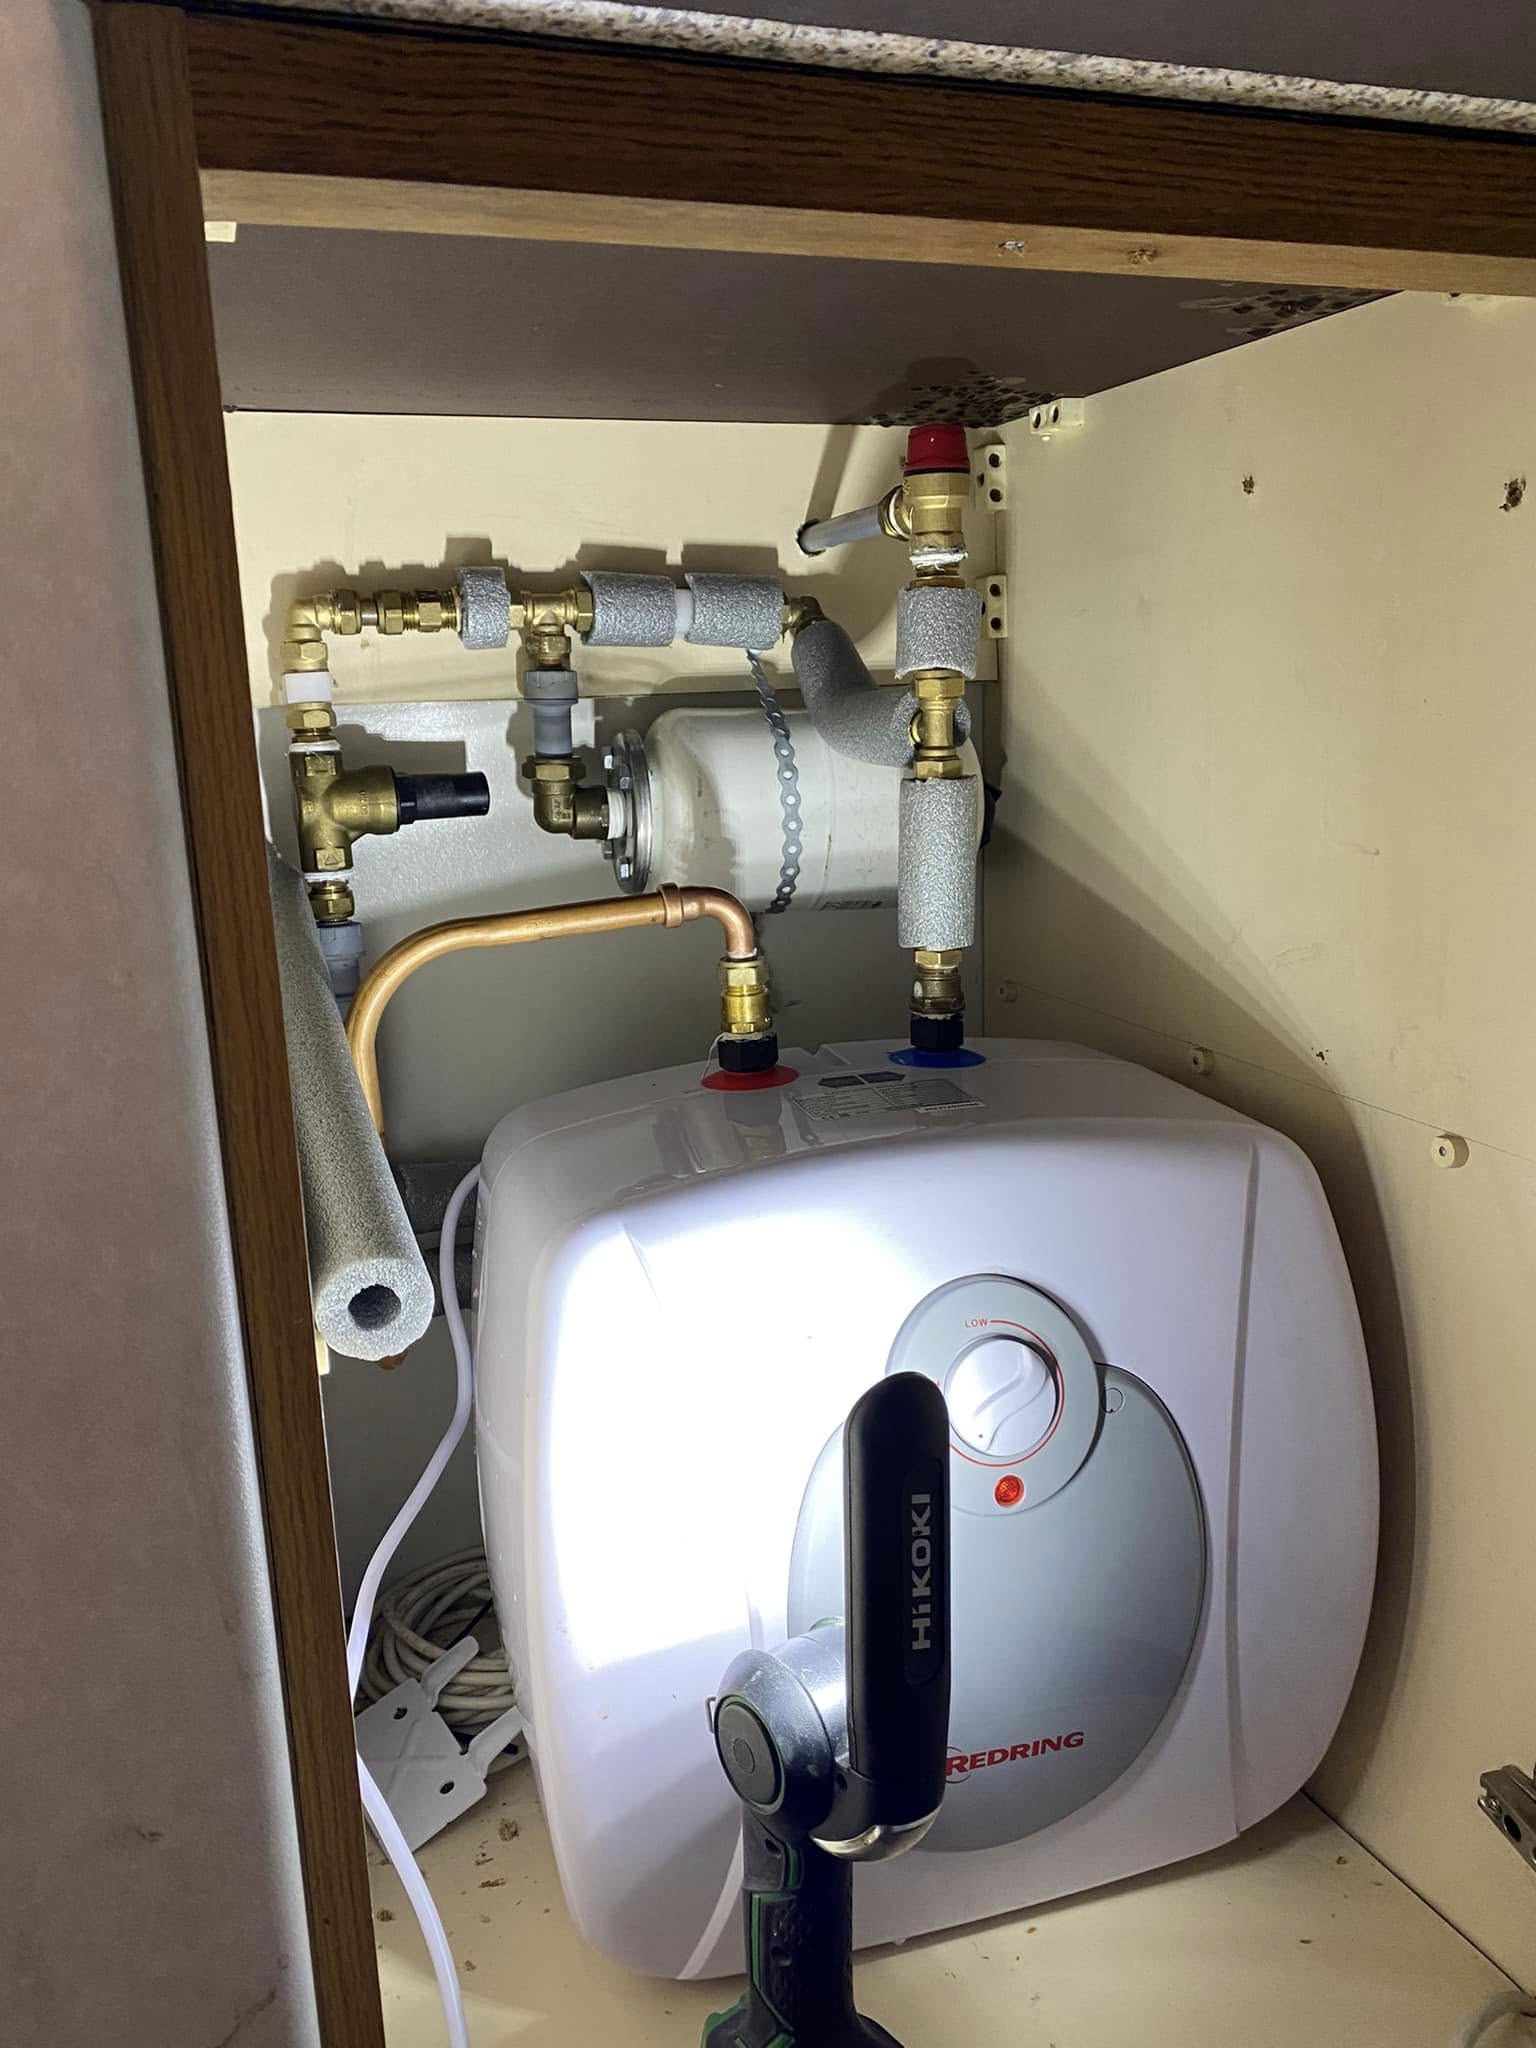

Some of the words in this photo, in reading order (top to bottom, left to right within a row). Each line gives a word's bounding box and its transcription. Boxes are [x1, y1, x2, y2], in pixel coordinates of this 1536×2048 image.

[964, 1318, 988, 1328] LOW
[911, 1494, 931, 1650] HiKOKI
[945, 1731, 1084, 1776] REDRING
